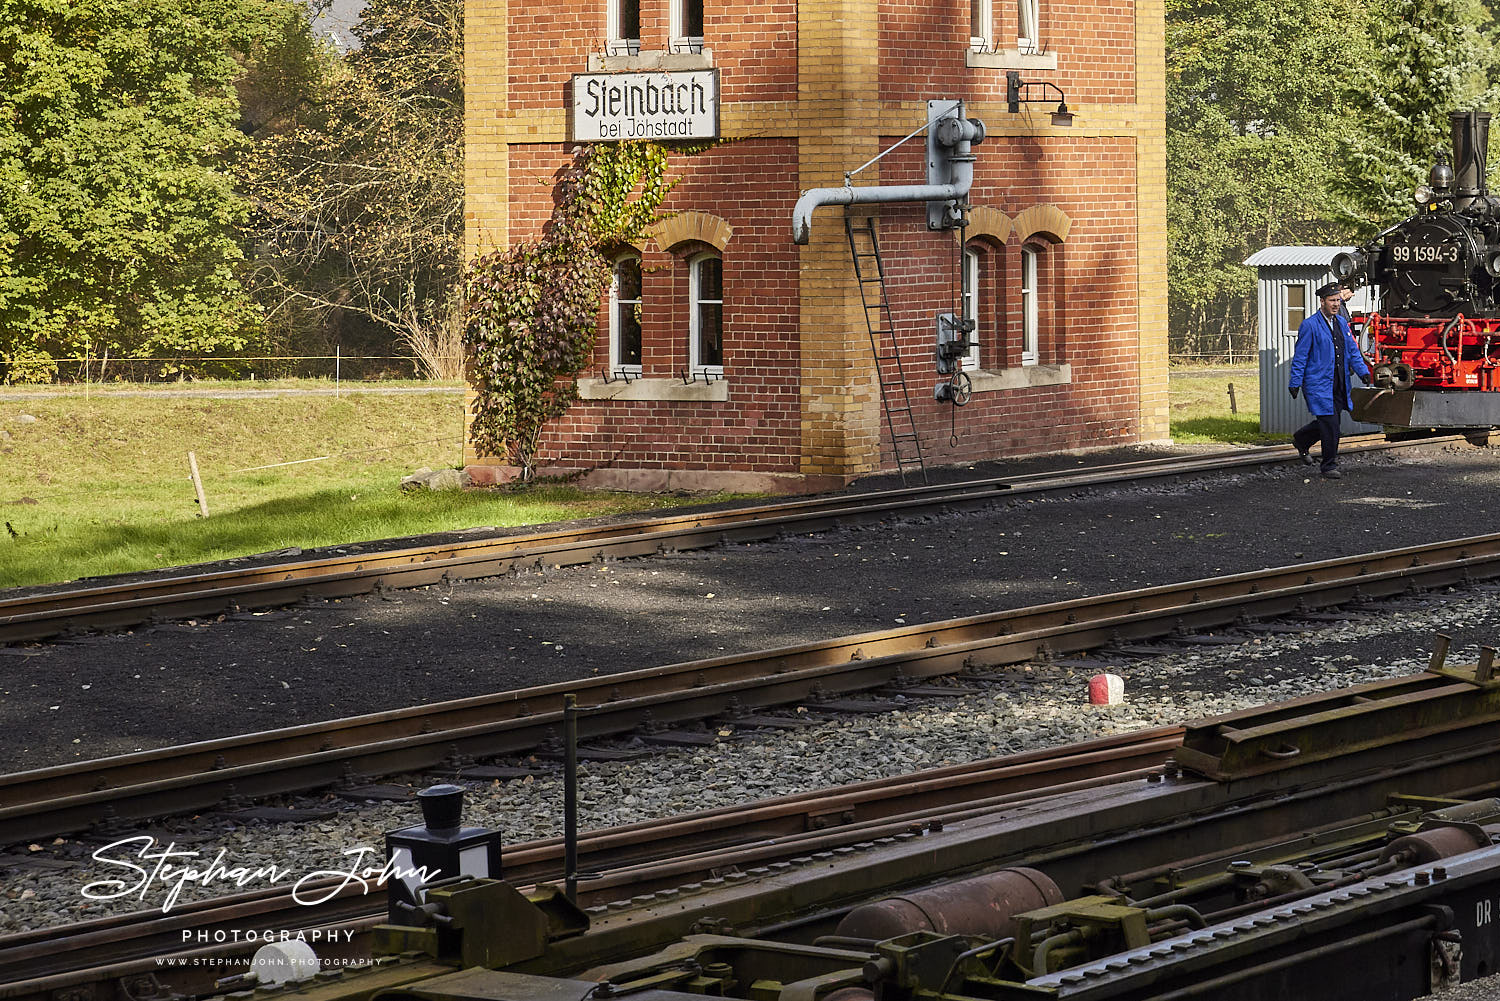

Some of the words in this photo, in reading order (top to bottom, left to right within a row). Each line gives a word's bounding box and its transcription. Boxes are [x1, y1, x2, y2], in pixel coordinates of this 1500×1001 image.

[585, 75, 706, 118] Steinbach
[599, 120, 621, 138] bei
[627, 117, 693, 137] Jöhstadt
[1393, 246, 1410, 262] 99
[1413, 246, 1458, 262] 1594-3
[1476, 899, 1491, 927] DR
